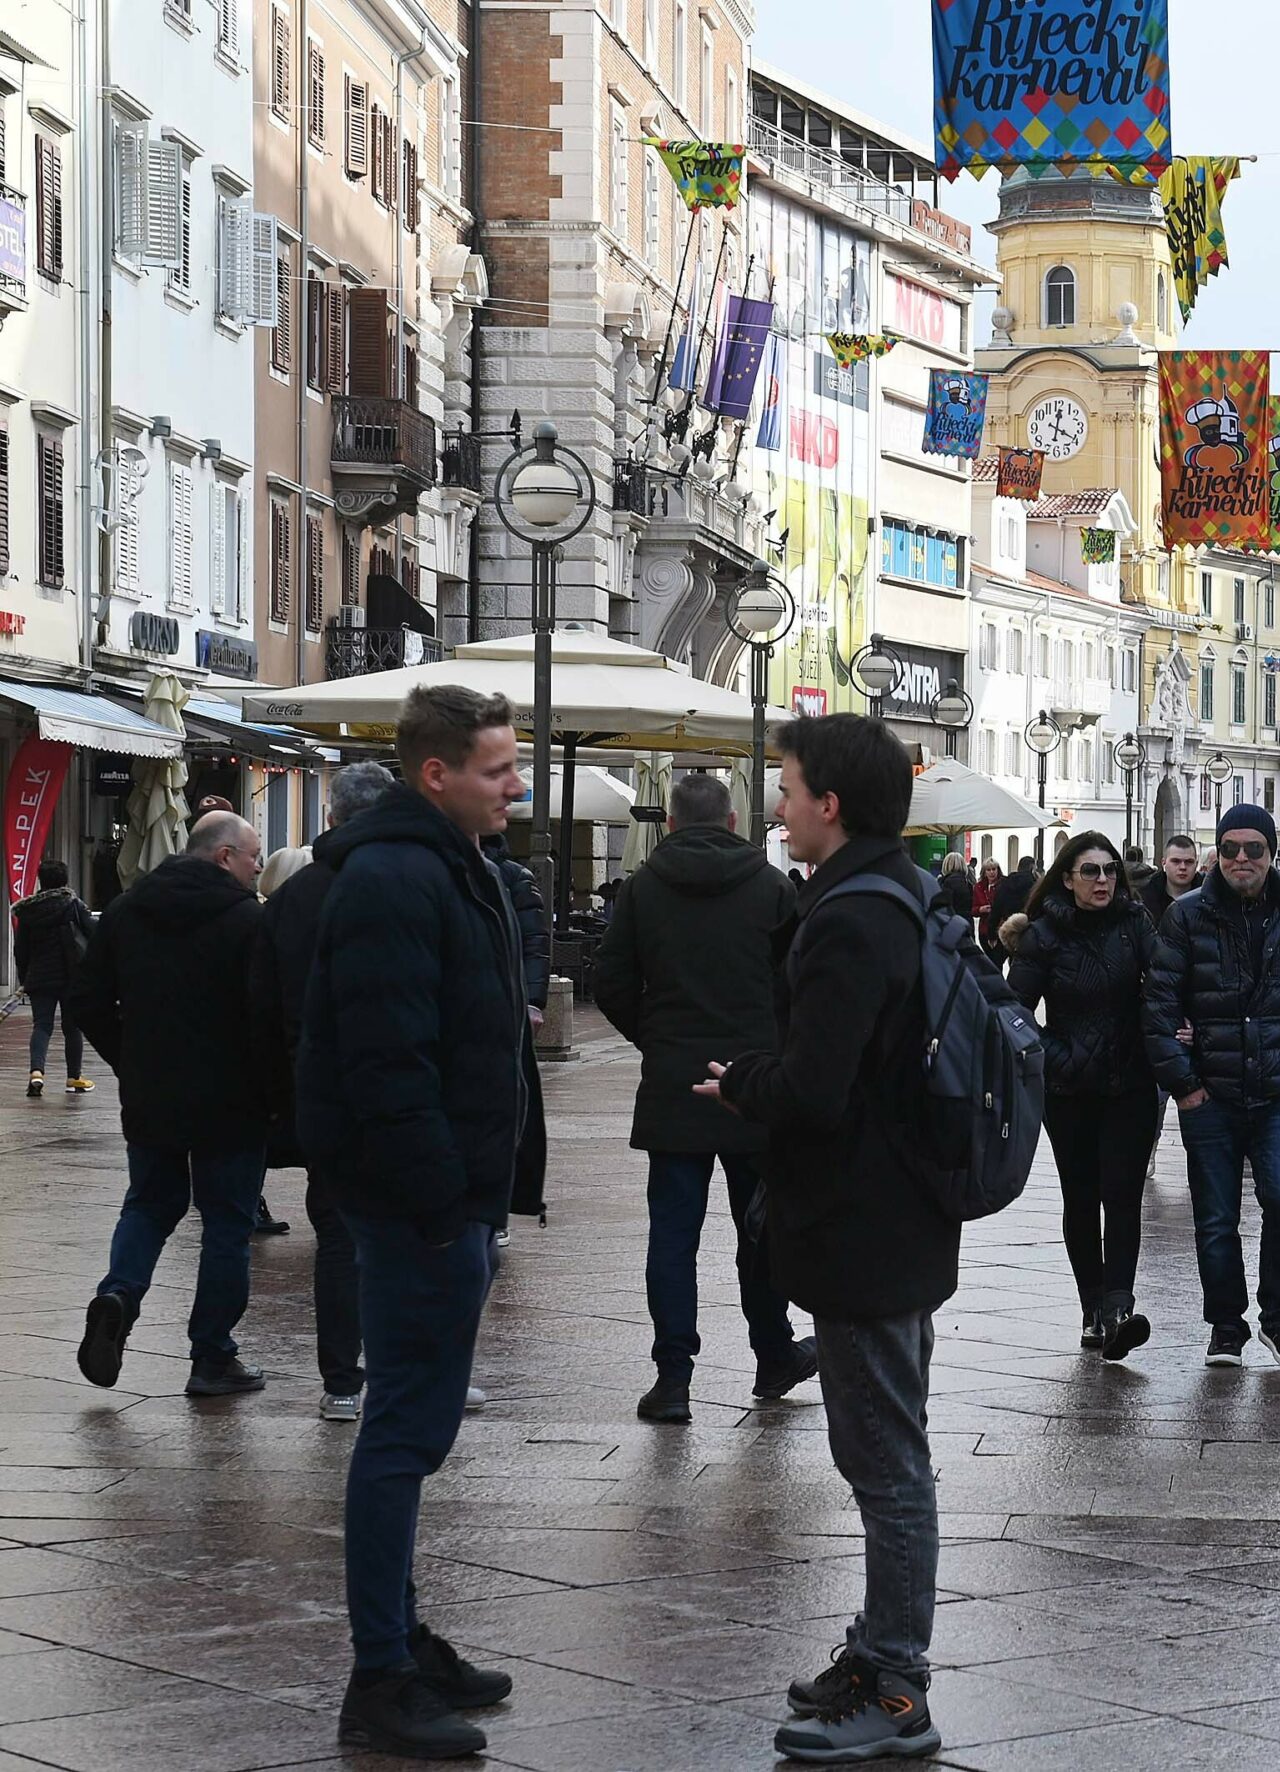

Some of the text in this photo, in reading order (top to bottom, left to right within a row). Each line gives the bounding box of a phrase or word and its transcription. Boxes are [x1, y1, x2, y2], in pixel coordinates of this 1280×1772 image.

[948, 43, 1149, 111] karneval
[895, 275, 944, 345] NKD
[1045, 402, 1052, 415] 11
[1054, 400, 1064, 412] 12
[1067, 403, 1071, 415] 1
[1035, 409, 1045, 421] 10
[1073, 409, 1079, 422] 2
[1030, 422, 1038, 435] 9
[1077, 421, 1084, 435] 3
[789, 406, 839, 470] NKD
[1035, 435, 1043, 447] 8
[1072, 434, 1079, 446] 4
[1053, 445, 1061, 458] 6
[1063, 443, 1071, 456] 5
[1168, 486, 1263, 519] karneval
[514, 711, 562, 723] ockl's
[13, 767, 47, 897] AN-PEK
